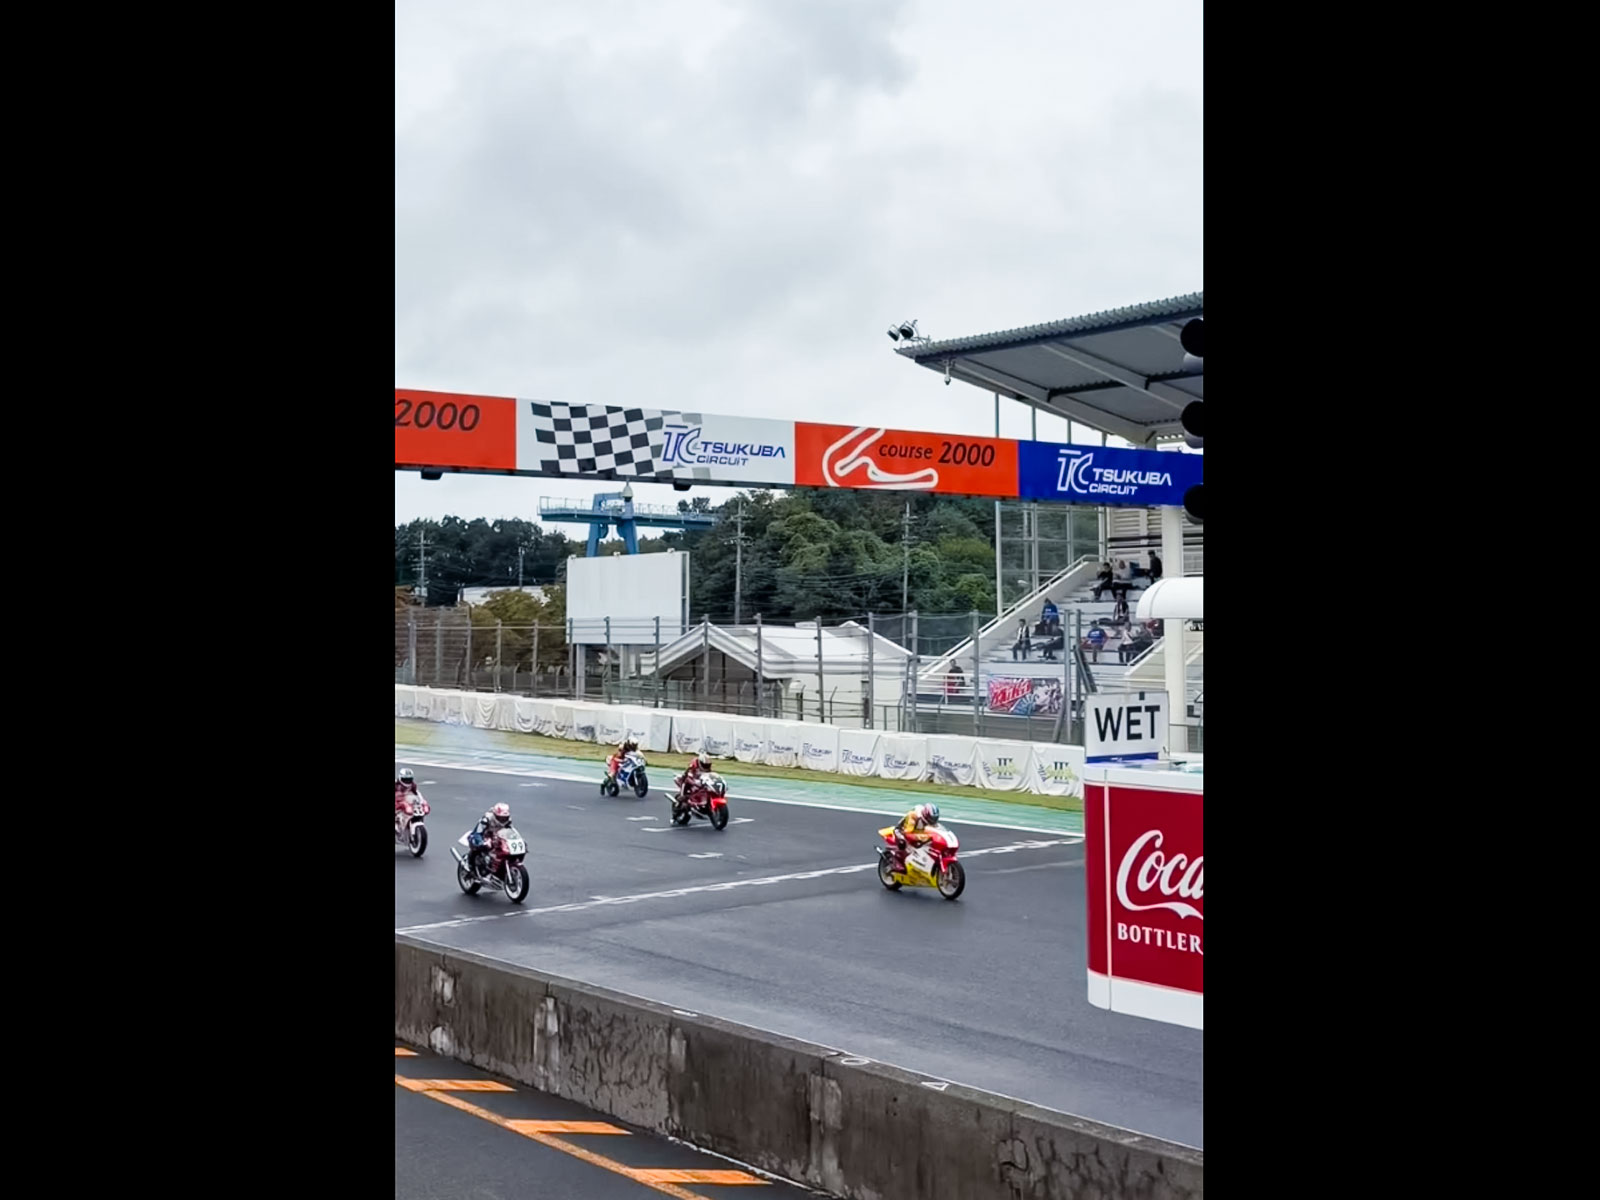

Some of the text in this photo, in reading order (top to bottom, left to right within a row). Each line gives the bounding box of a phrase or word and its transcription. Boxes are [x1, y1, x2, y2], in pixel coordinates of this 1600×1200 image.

[395, 398, 480, 431] 2000
[701, 441, 786, 458] TSUKUBA
[879, 441, 995, 467] course 2000
[1093, 467, 1173, 487] TSUKUBA
[1094, 705, 1160, 742] WET
[1116, 829, 1203, 919] Coca
[1117, 922, 1203, 956] BOTTLER
